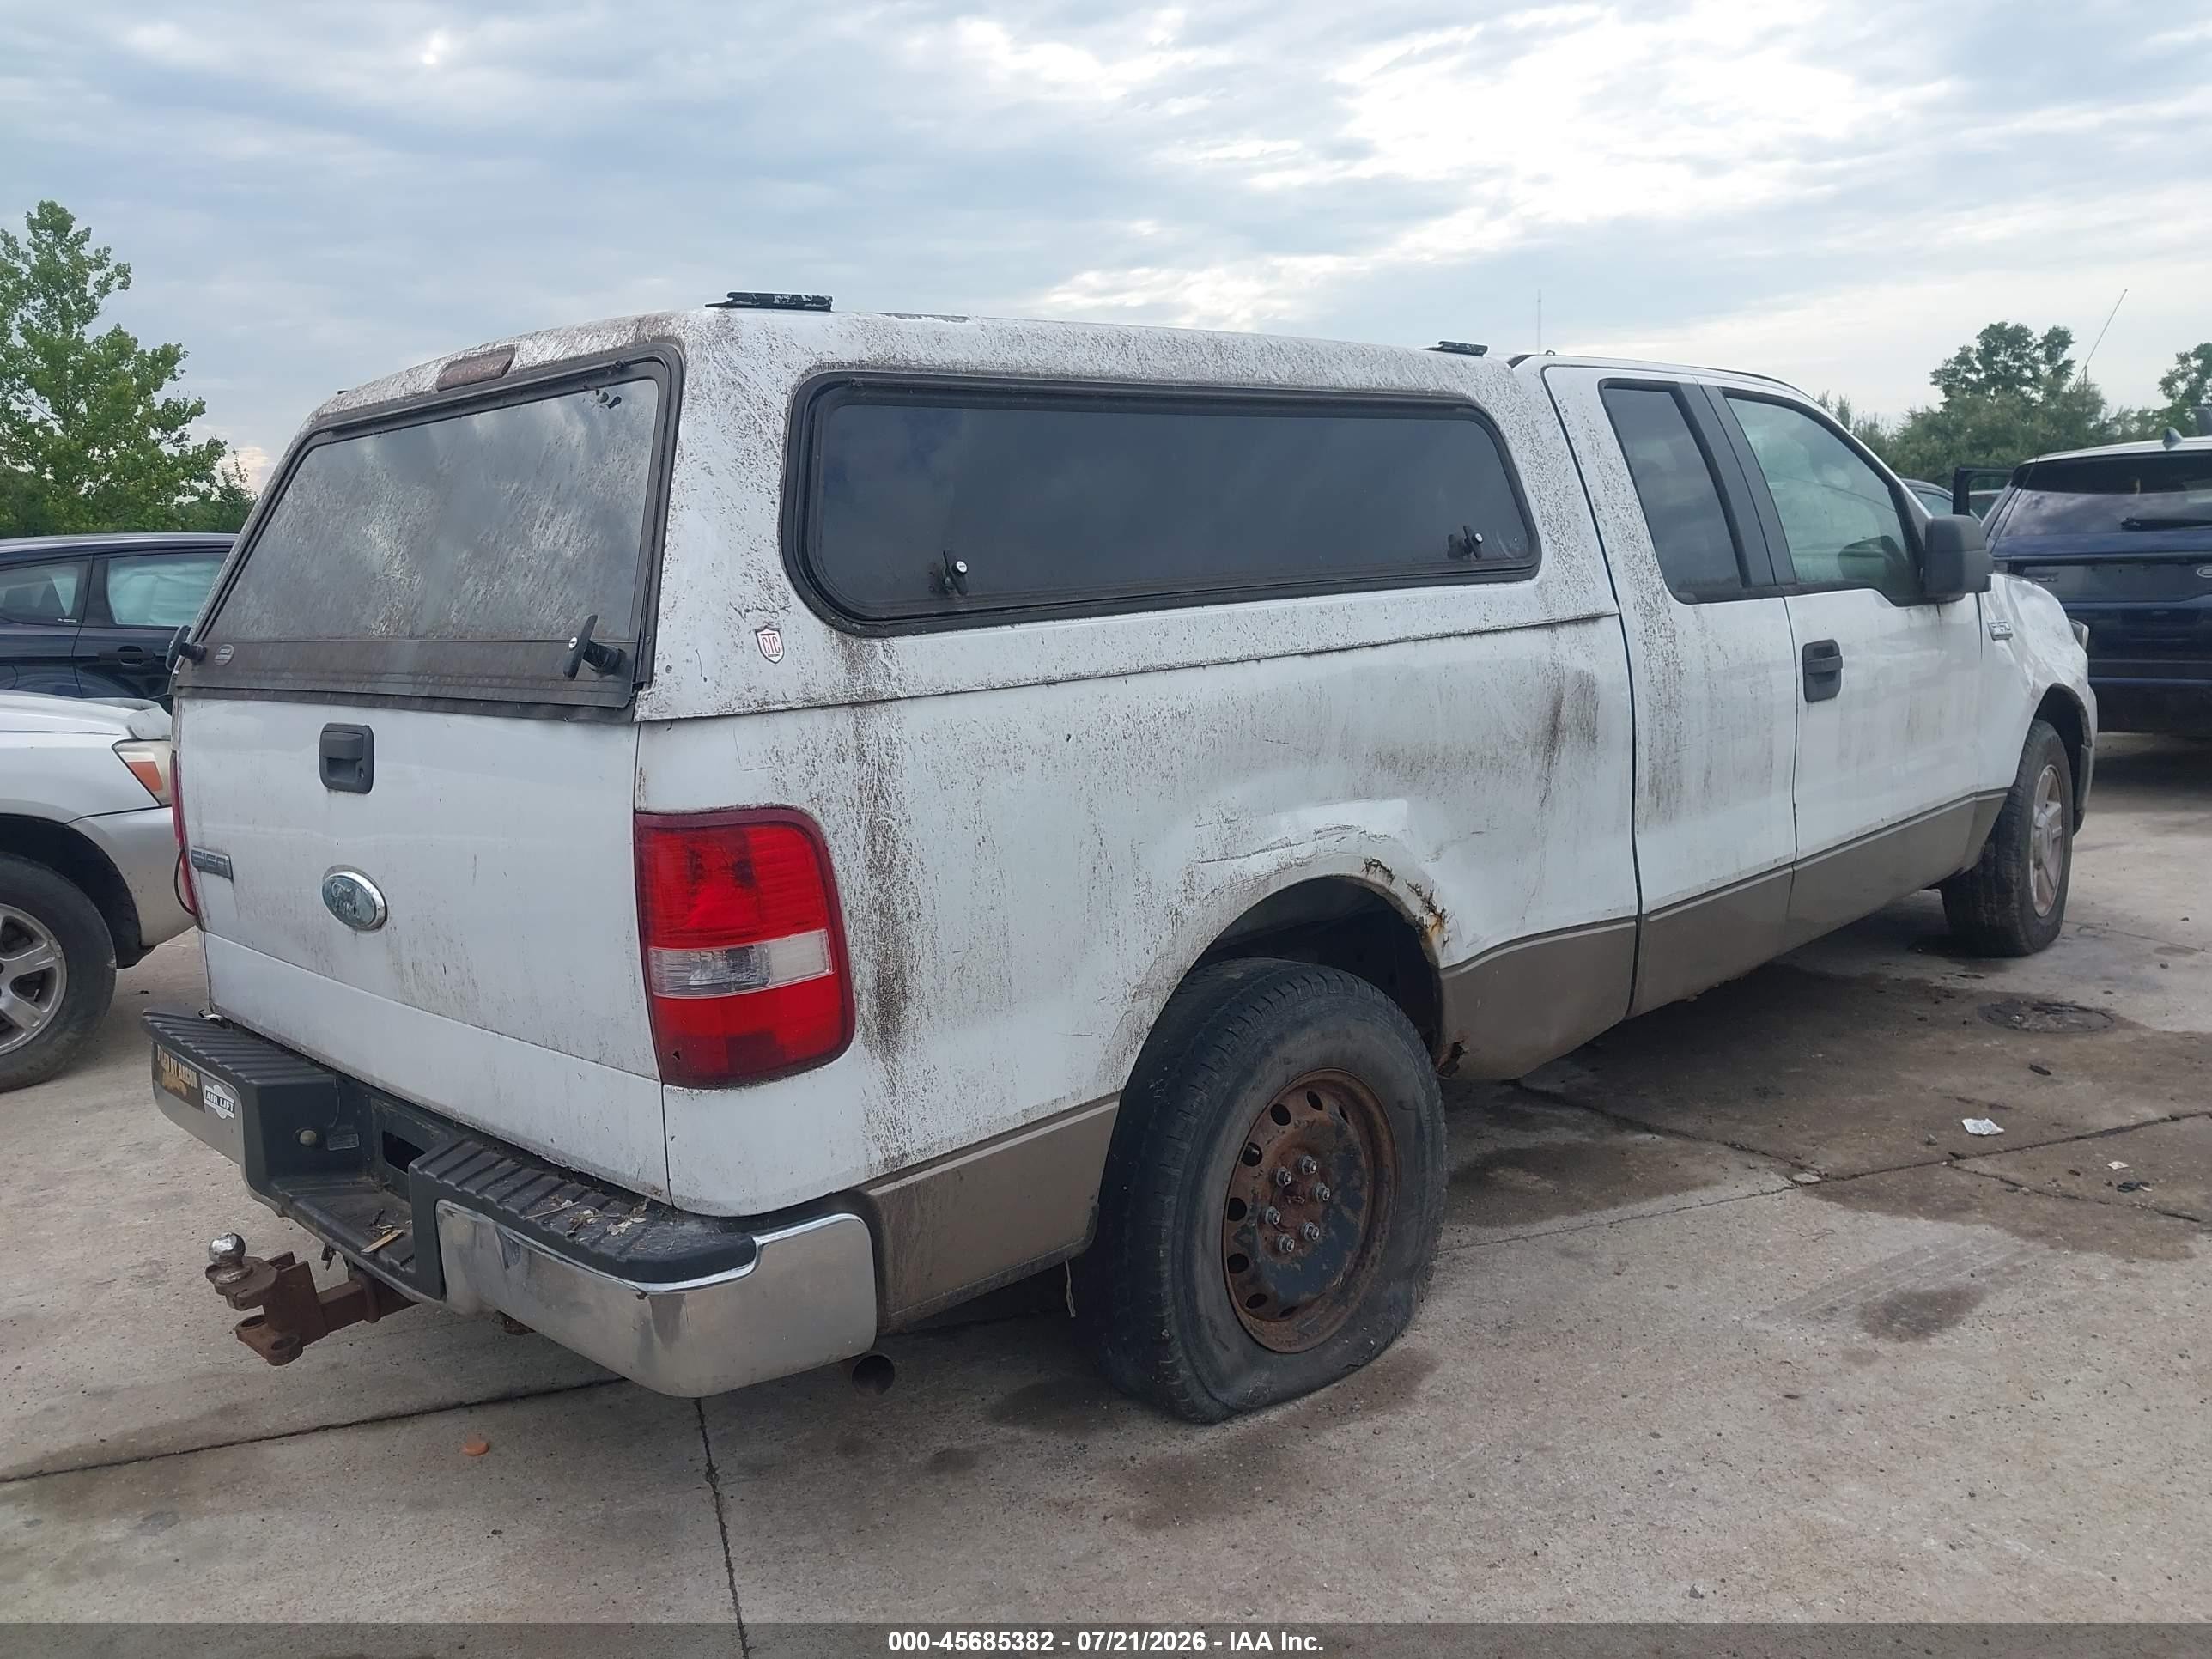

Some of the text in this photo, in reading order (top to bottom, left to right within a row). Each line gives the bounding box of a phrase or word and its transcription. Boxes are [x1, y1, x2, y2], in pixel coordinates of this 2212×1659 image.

[331, 882, 362, 919] Ford
[206, 1091, 234, 1113] AIR LIFT
